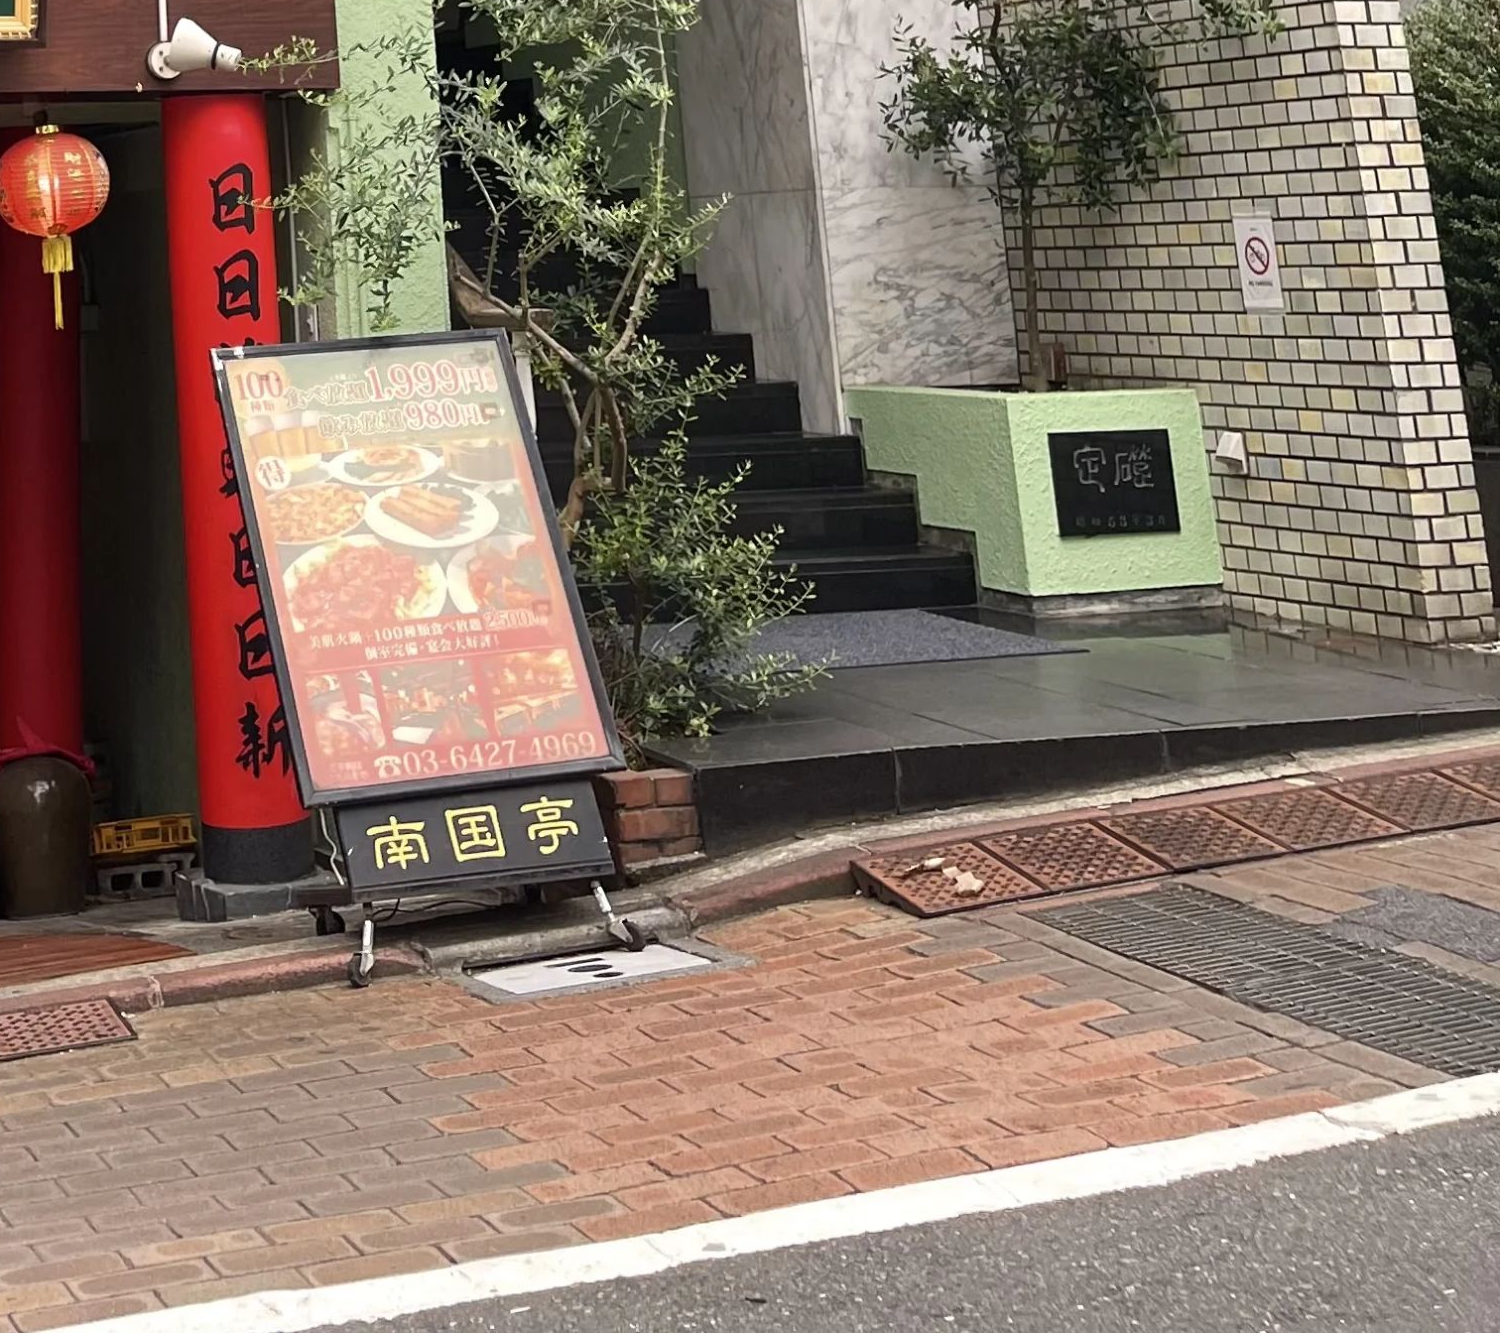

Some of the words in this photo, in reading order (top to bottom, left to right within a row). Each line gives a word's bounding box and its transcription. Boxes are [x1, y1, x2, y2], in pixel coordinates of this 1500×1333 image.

[403, 731, 597, 776] 03-6427-4969
[365, 794, 579, 871] 南国亭
